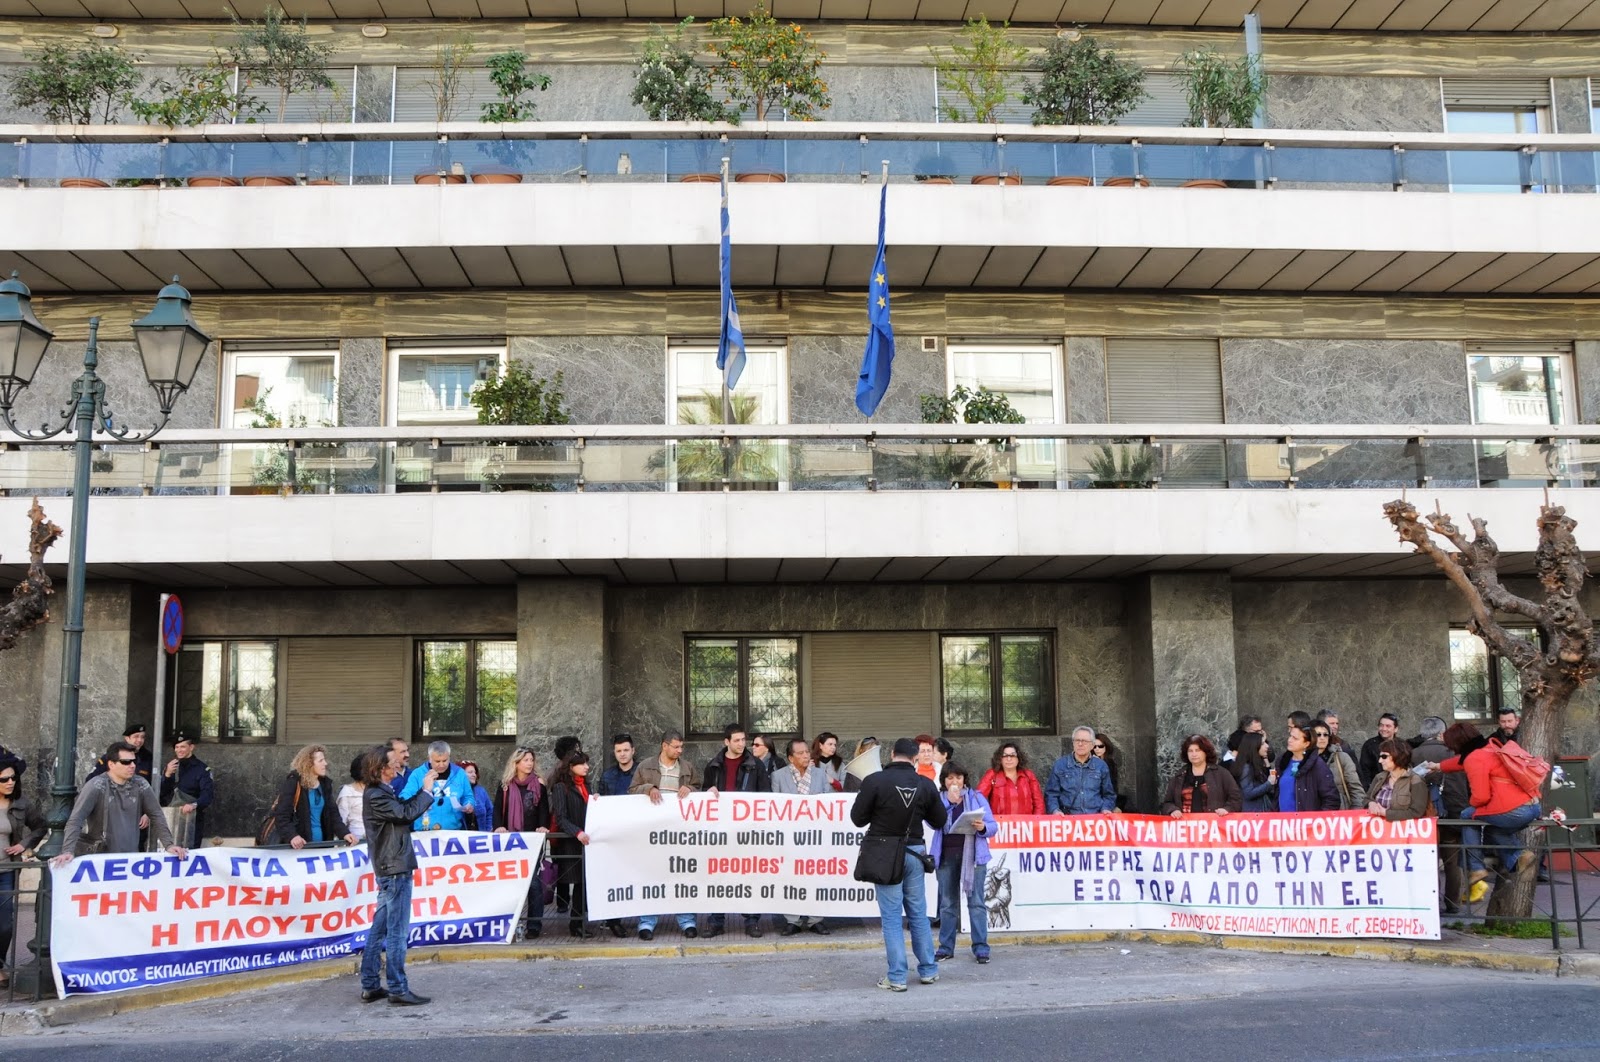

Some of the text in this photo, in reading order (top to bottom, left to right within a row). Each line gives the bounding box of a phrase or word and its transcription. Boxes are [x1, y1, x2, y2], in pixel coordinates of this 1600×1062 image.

[679, 799, 848, 822] WE DEMANT
[649, 829, 864, 846] education which will mee
[995, 816, 1433, 844] ΜΗΝ ΠΕΡΑΣΟΥΝ ΤΑ ΜΕΤΡΑ ΠΟΥ ΠΝΙΓΟΥΝ ΤΟ ΛΑΟ
[70, 832, 529, 884] ΛΕΦΤΑ ΓΙΑ ΤΗΝ ΑΙΔΕΙΑ
[669, 855, 849, 876] the peoples' needs
[1019, 848, 1414, 874] ΜΟΝΟΜΕΡΗΣ ΔΙΑΓΡΑΦΗ ΤΟΥ ΧΡΕΟΥΣ
[71, 858, 529, 918] ΤΗΝ ΚΡΙΣΗ ΝΑ ΠΡΩΣΕΙ
[607, 883, 877, 903] and not the needs of the monopo
[1074, 878, 1384, 906] ΕΞΩ ΤΩΡΑ ΑΠΟ ΤΗΝ Ε.Ε.
[151, 895, 464, 947] Η ΠΛΟΥΤΟΚΤΙΑ
[1170, 911, 1222, 931] ΣΥΛΛΟΓΟΣ
[1224, 915, 1317, 934] ΕΚΠΑΙΔΕΥΤΙΚΩΝ
[1319, 917, 1342, 934] Π.Ε.
[67, 967, 139, 988] ΣΥΛΛΟΓΟΣ
[144, 955, 249, 981] ΕΚΠΑΙΔΕΥΤΙΚΩΝ
[251, 952, 276, 969] Π.Ε.
[278, 948, 298, 965] ΑΝ.
[300, 942, 352, 961] ΑΤΤΙΚΗΣ
